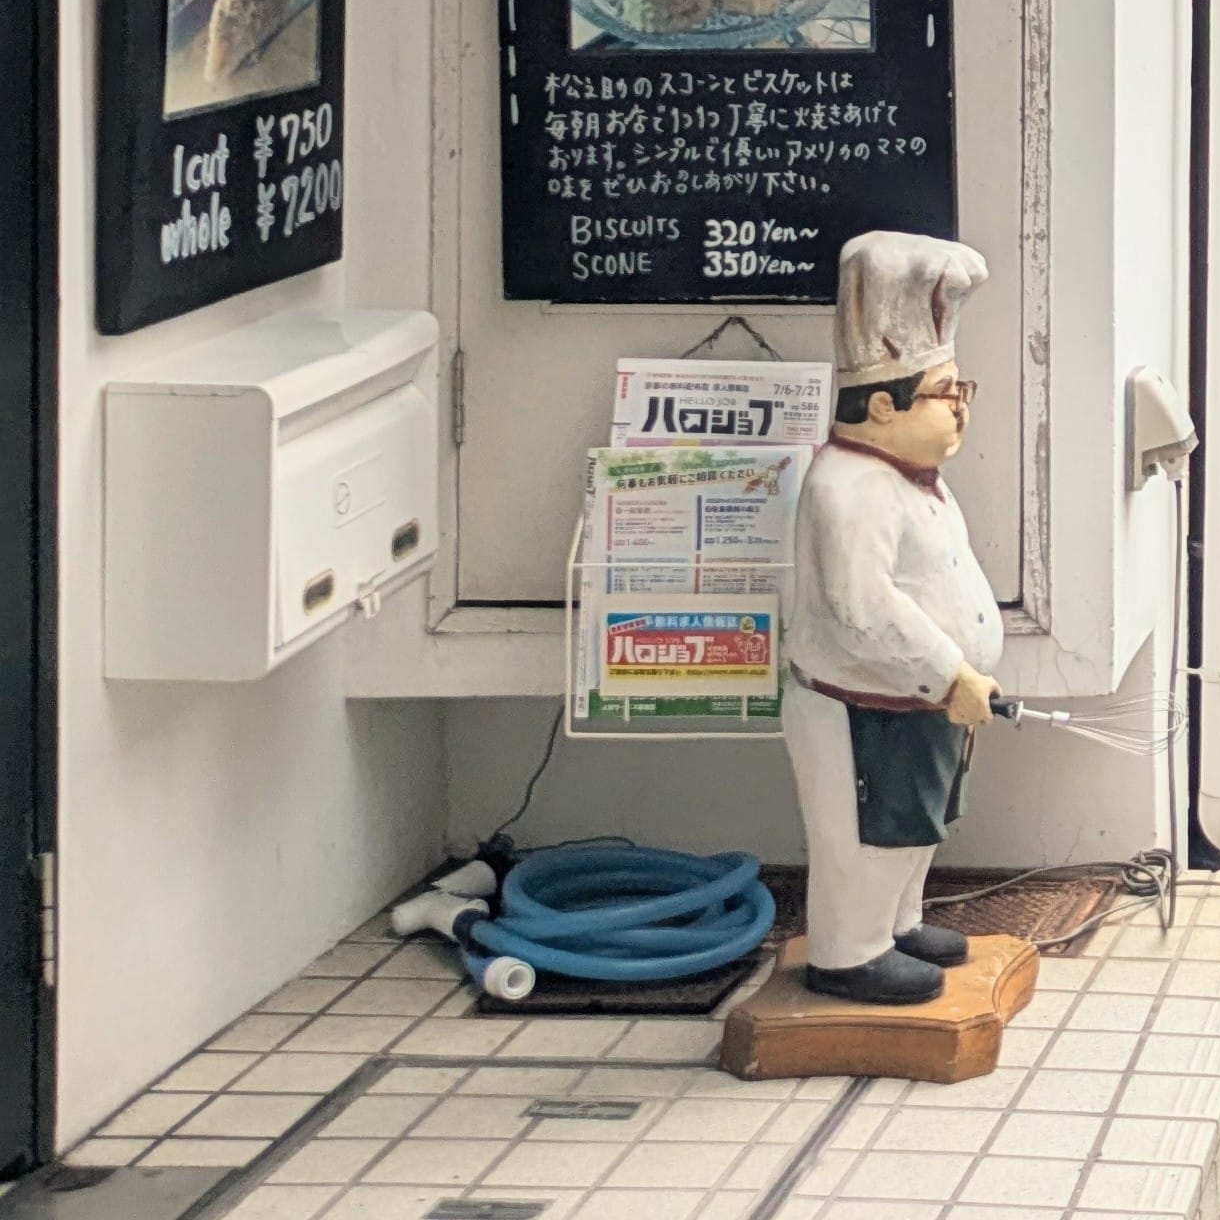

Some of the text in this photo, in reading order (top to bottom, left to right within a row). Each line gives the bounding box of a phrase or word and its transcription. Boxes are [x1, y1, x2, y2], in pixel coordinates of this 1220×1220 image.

[161, 191, 232, 264] whole
[703, 219, 756, 247] 320
[702, 250, 757, 277] 350
[641, 396, 785, 436] ハロジョブ
[611, 635, 715, 664] ハロジョブ
